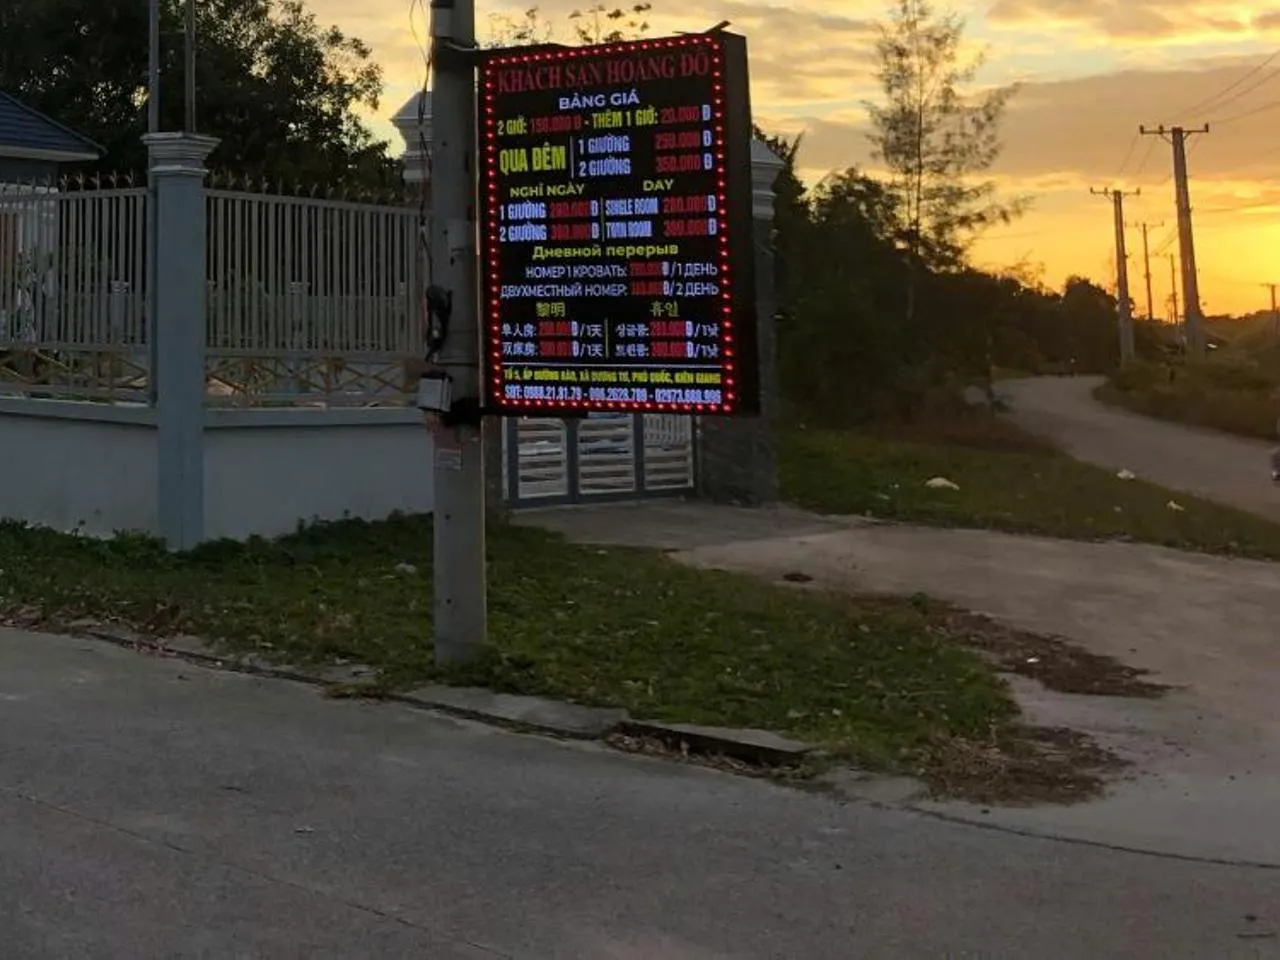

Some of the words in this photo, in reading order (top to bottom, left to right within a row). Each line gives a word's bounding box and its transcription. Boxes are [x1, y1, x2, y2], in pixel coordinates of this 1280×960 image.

[498, 62, 561, 93] KHÁCH
[566, 60, 603, 89] SẠN
[610, 88, 641, 105] GIÁ
[497, 120, 505, 135] 2
[592, 108, 623, 129] THÊM
[625, 110, 632, 127] 1
[578, 139, 585, 155] 1
[588, 132, 630, 154] GIƯỜNG
[500, 147, 528, 175] QUA
[532, 141, 566, 172] ĐÊM
[579, 160, 587, 177] 2
[588, 155, 631, 175] GIƯỜNG
[655, 154, 701, 172] 350.000
[547, 182, 585, 196] NGÀY
[643, 179, 674, 191] DAY
[499, 204, 505, 220] 1
[508, 200, 546, 220] GIƯỜNG
[499, 226, 507, 242] 2
[508, 221, 547, 242] GIƯỜNG
[532, 243, 601, 260] Дневной
[606, 244, 679, 259] перерыв
[525, 265, 566, 279] НОМЕР
[684, 261, 718, 277] ДЕНЬ
[500, 282, 583, 298] ДВУХМЕСТНЫЙ
[684, 281, 719, 296] ДЕНЬ
